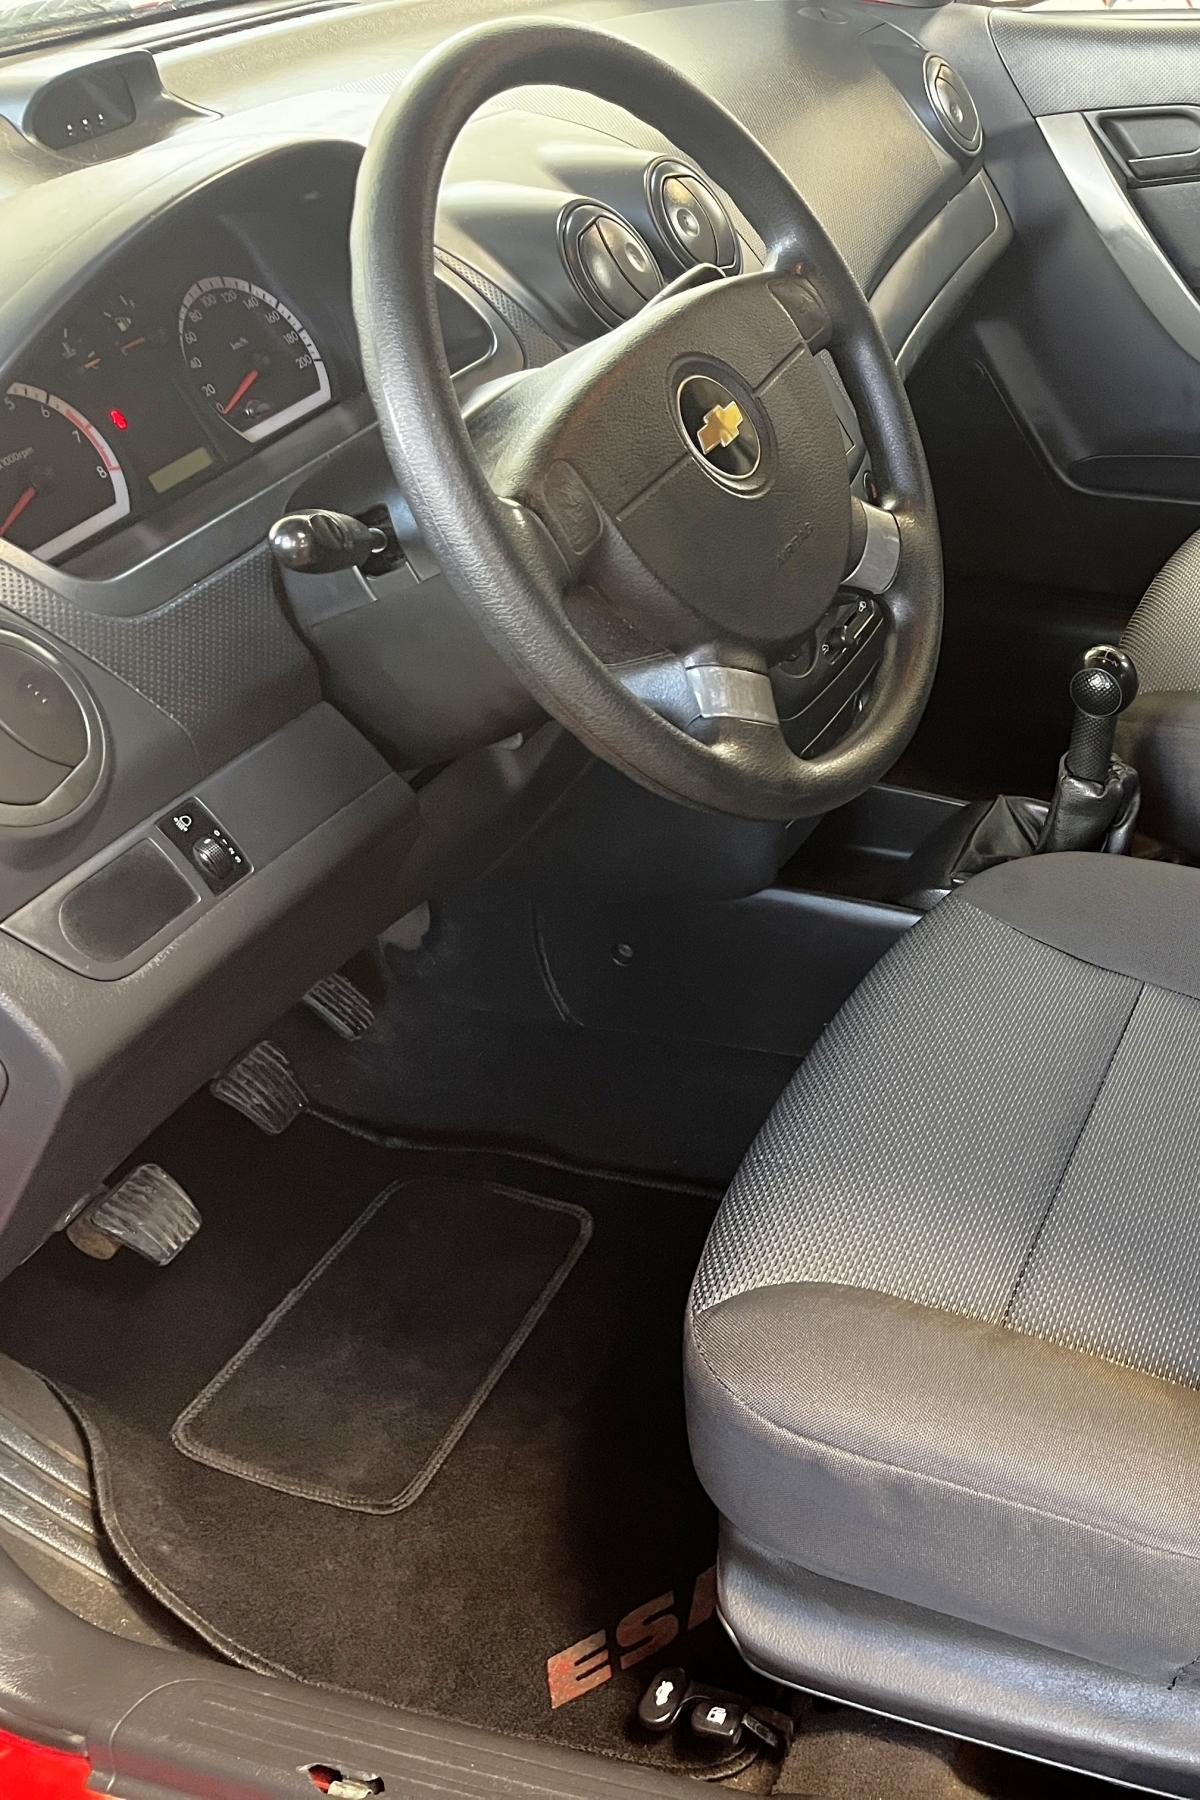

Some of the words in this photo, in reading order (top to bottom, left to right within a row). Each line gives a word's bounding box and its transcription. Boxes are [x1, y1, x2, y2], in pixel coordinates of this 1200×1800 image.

[200, 294, 217, 308] 100
[220, 289, 237, 303] 120
[243, 296, 259, 310] 140
[189, 310, 202, 322] 80
[265, 310, 281, 324] 160
[185, 331, 197, 344] 60
[283, 330, 299, 345] 180
[190, 356, 202, 369] 40
[295, 354, 312, 368] 200
[202, 383, 216, 397] 20
[40, 405, 50, 418] 6
[216, 402, 224, 414] 0
[72, 430, 81, 444] 7
[96, 466, 107, 478] 8
